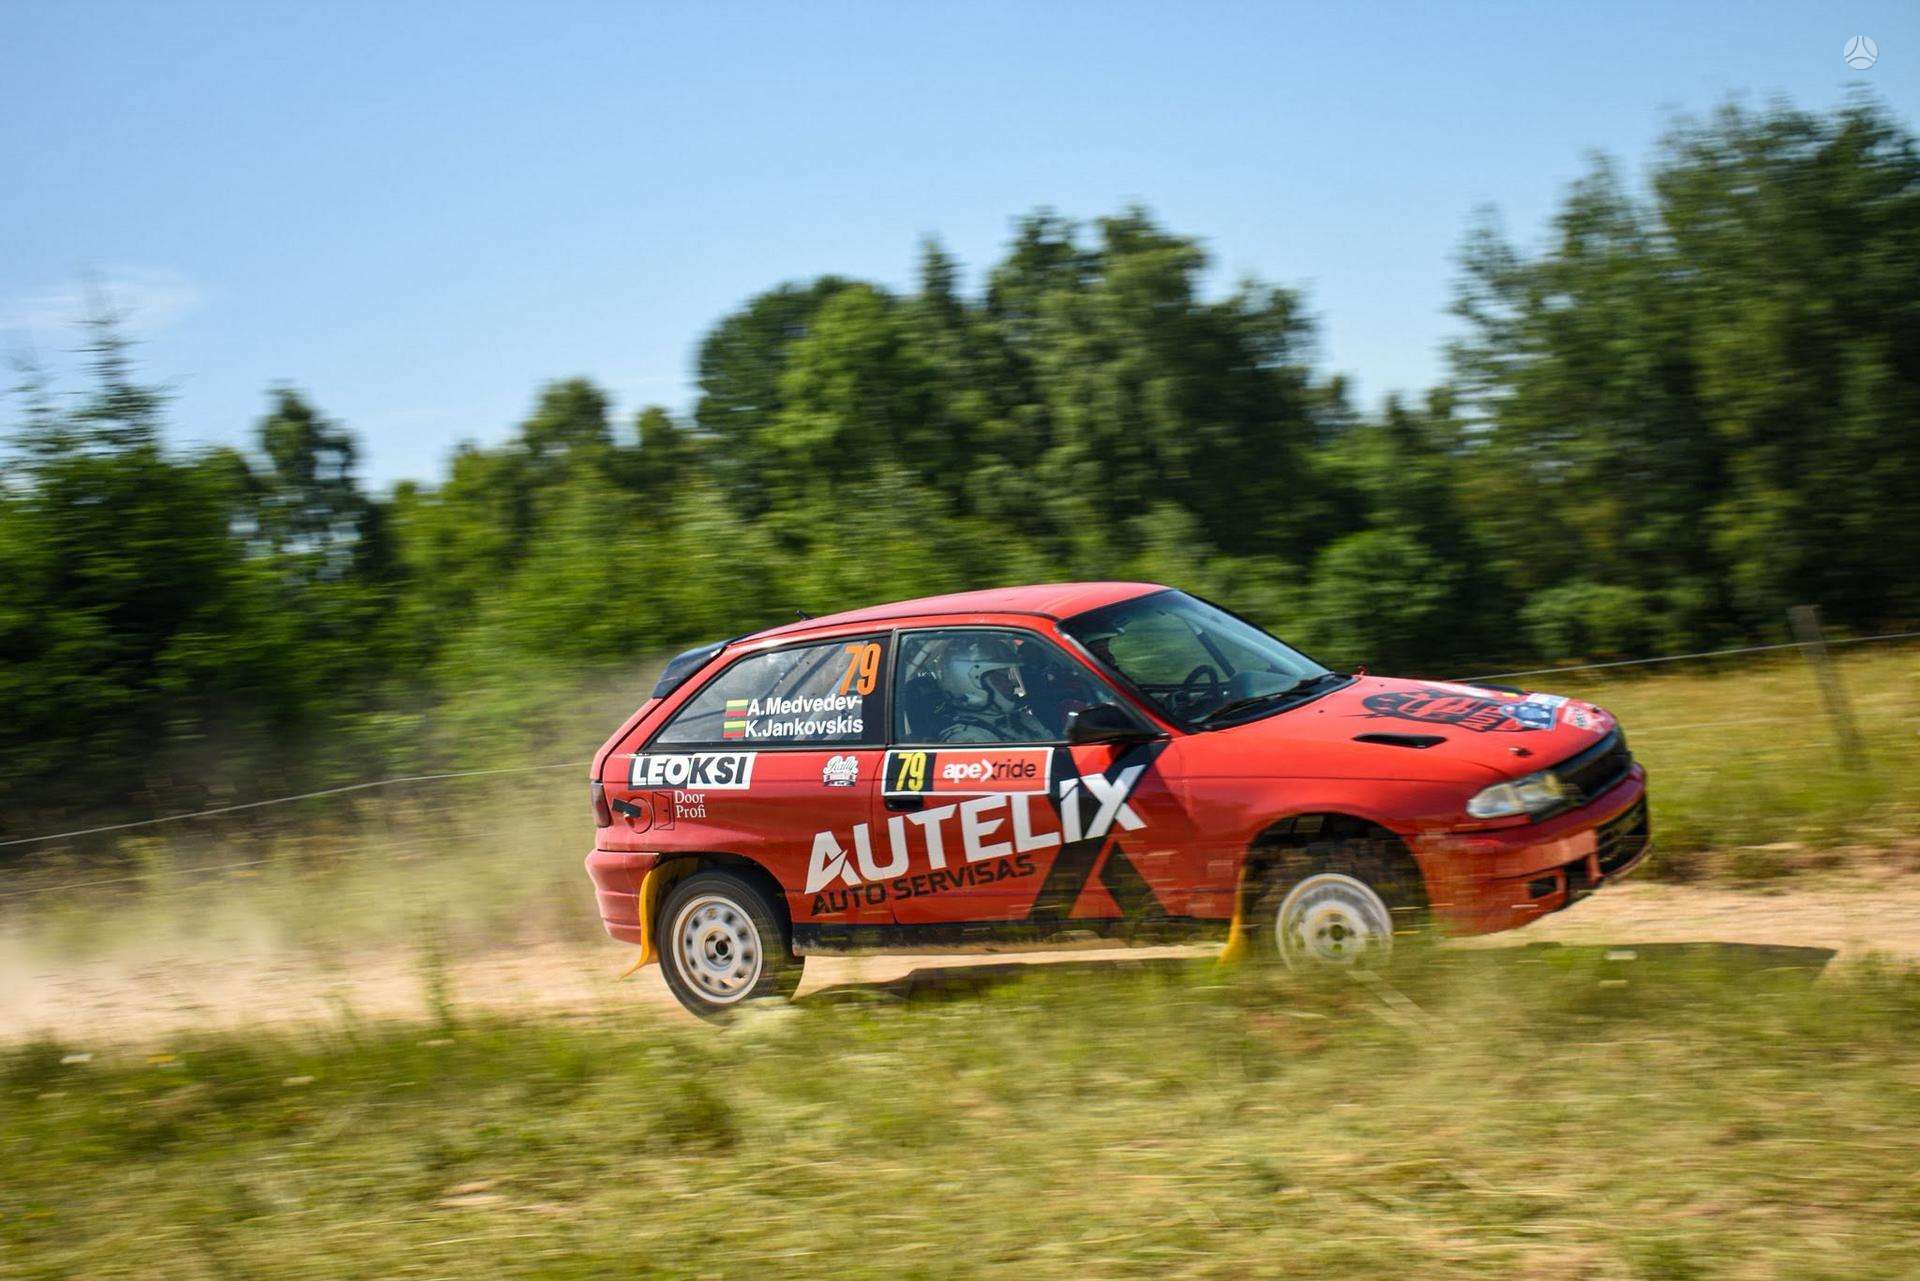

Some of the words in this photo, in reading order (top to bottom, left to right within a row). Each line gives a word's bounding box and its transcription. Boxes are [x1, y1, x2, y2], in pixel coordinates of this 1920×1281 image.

[839, 643, 882, 696] 79
[745, 714, 864, 738] K.Jankovskis
[632, 756, 749, 785] LEOKSI
[896, 752, 927, 791] 79
[674, 790, 705, 804] Door
[676, 804, 707, 818] Profi
[804, 764, 1146, 895] AUTELIX
[811, 882, 886, 916] AUTO
[892, 854, 1037, 900] SERVISAS
